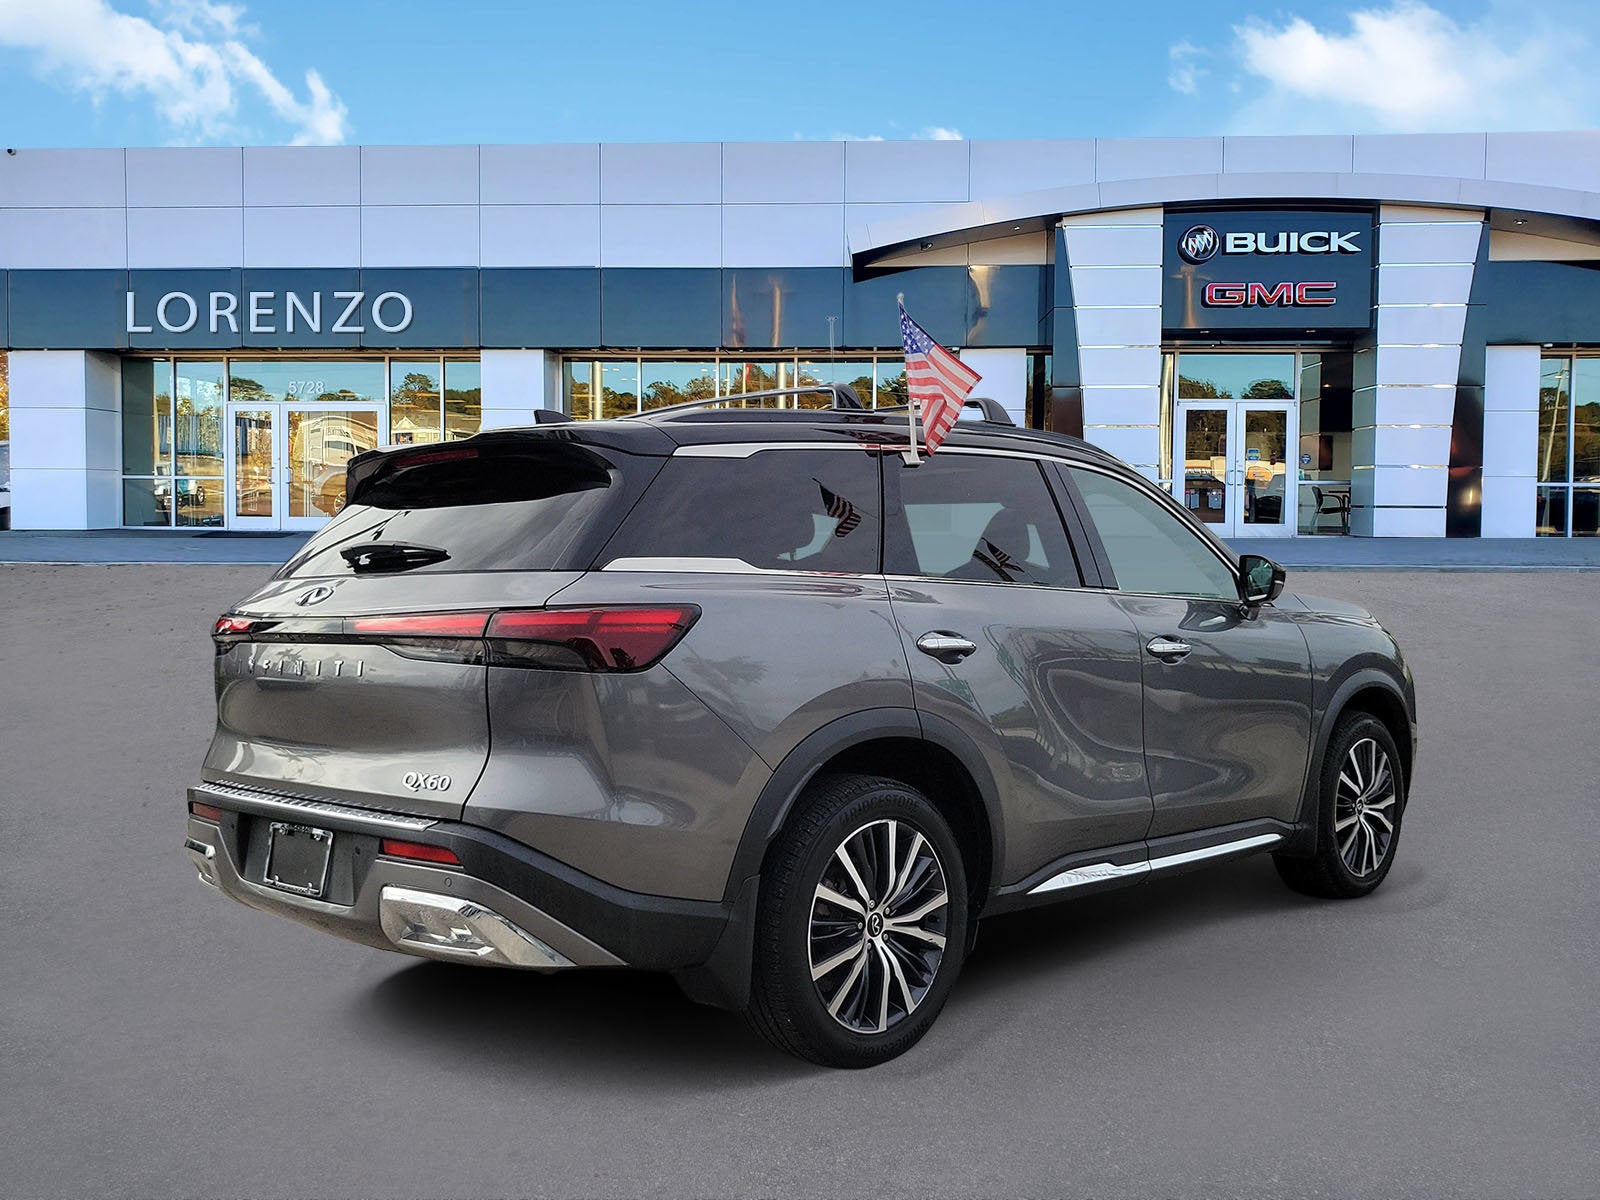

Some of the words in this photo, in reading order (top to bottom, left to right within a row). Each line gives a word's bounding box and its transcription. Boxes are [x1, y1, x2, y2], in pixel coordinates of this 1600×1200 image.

[1224, 231, 1362, 253] BUICK
[1204, 281, 1337, 306] GMC
[125, 291, 414, 333] LORENZO
[288, 380, 325, 394] 5728
[401, 771, 452, 792] QX60
